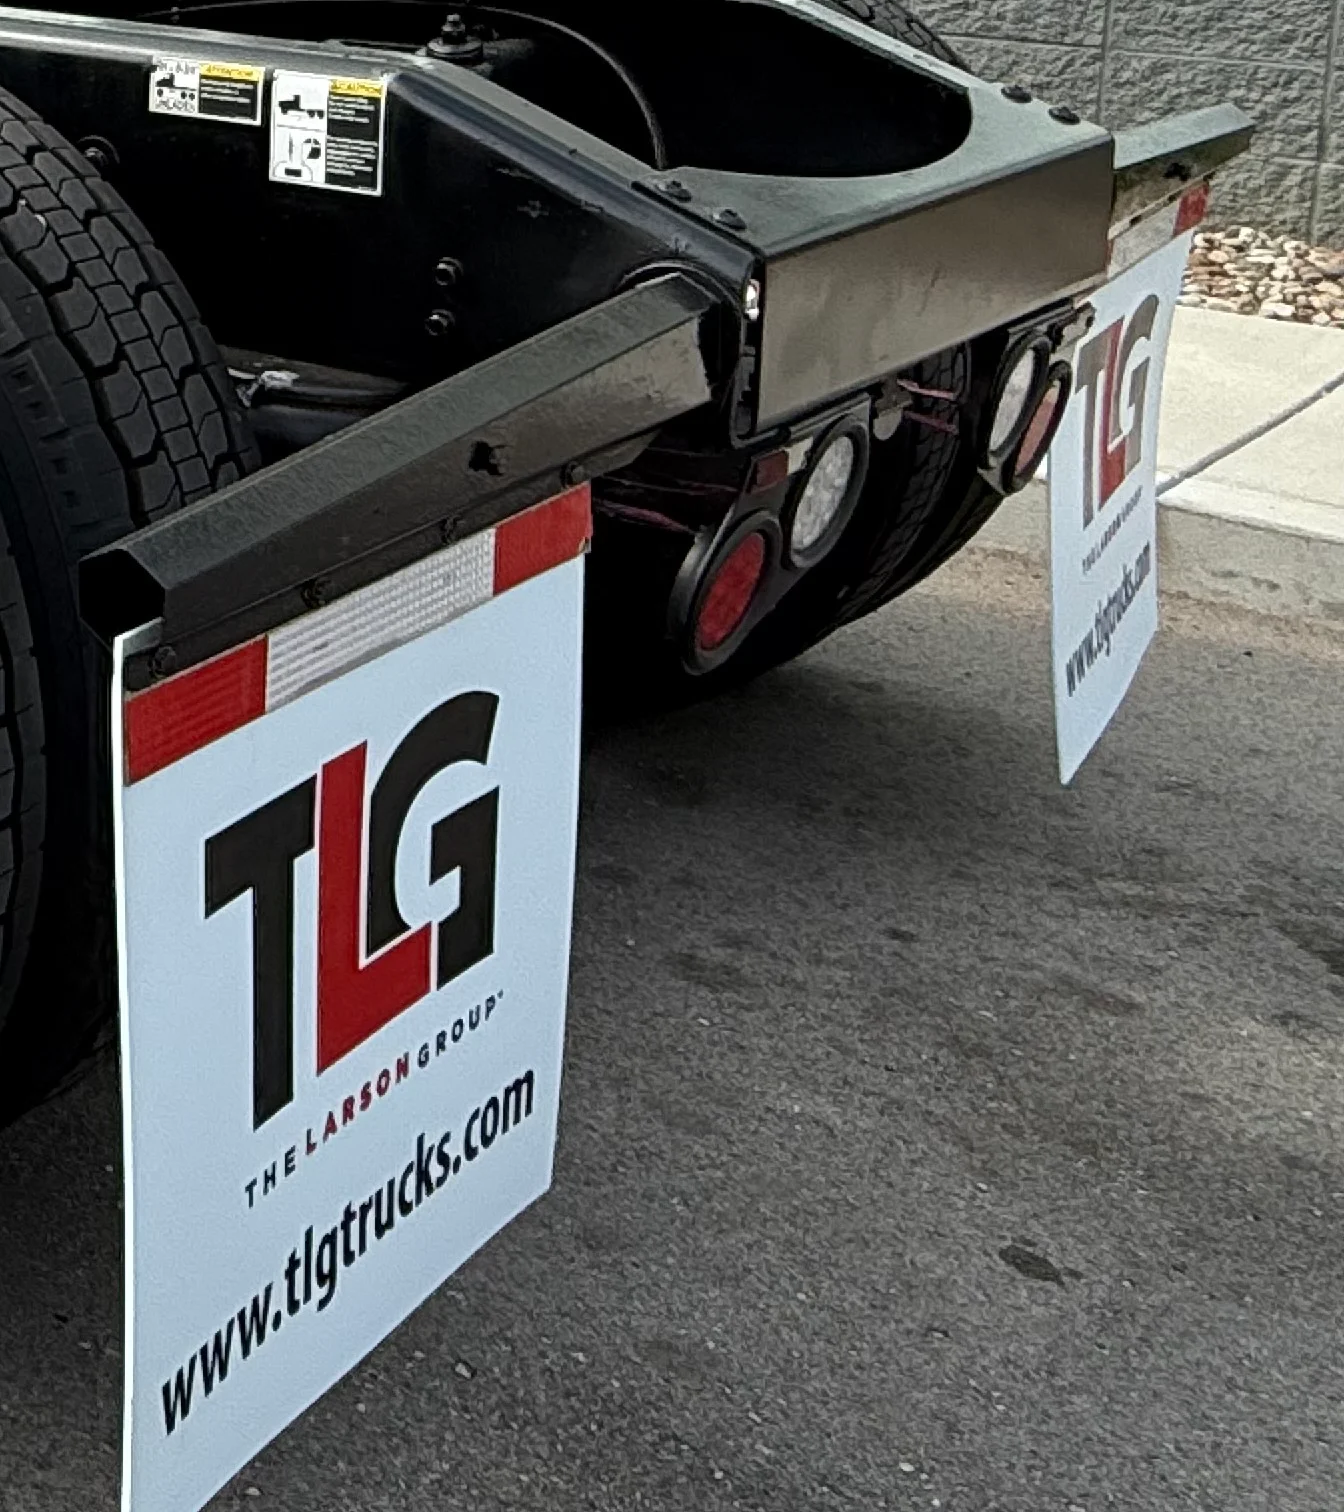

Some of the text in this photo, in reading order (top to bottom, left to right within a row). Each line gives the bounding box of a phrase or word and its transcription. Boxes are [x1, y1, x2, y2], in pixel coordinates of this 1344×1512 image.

[1075, 293, 1161, 532] TLG
[202, 689, 501, 1135] TLG
[159, 1065, 536, 1437] www.tlgtrucks.com
[243, 990, 500, 1209] THE LARSON GROUP
